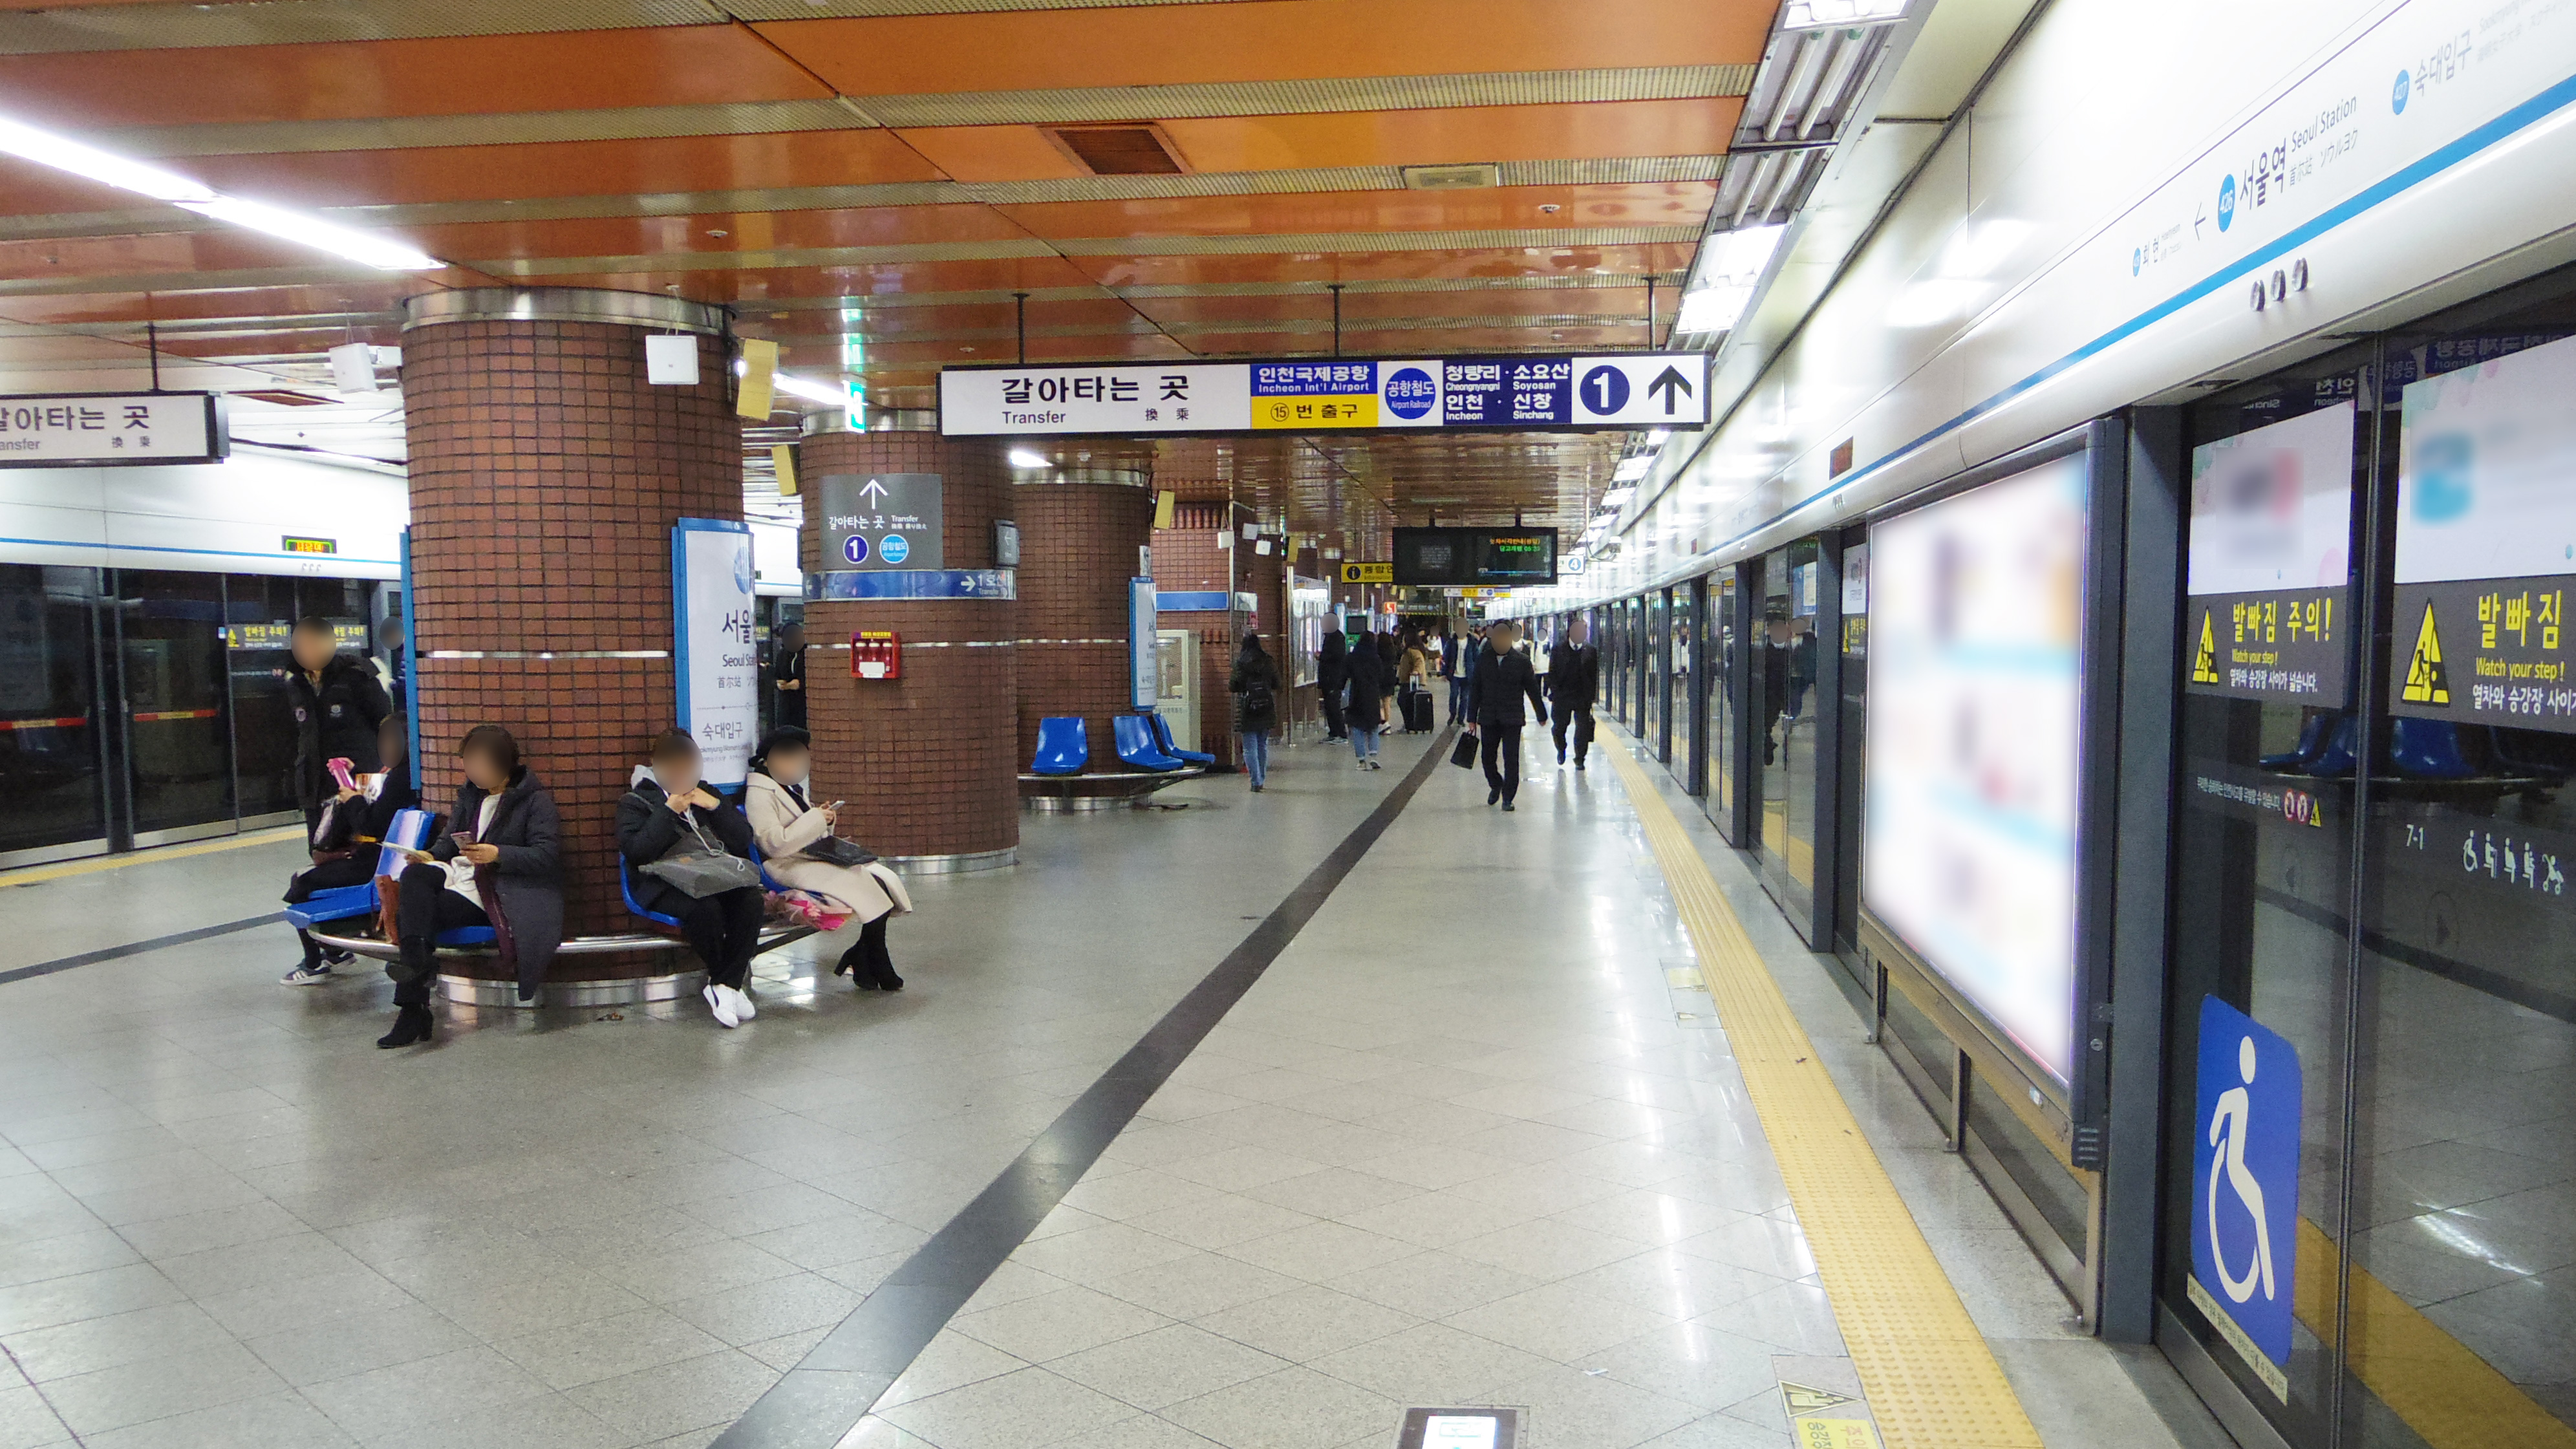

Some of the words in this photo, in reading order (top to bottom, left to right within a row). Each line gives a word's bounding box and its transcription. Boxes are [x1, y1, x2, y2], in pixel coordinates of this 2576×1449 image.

[2415, 29, 2472, 97] 숙대입구
[2292, 116, 2318, 153] Seoul
[2320, 96, 2356, 134] Station
[2240, 138, 2286, 210] 서울역
[2220, 189, 2233, 214] 426
[1258, 365, 1369, 383] 인천국제공항
[1446, 364, 1500, 381] 청량리
[1513, 364, 1570, 380] 소요산
[1002, 376, 1139, 404] 갈아타는
[1159, 375, 1189, 402] 곳
[1259, 383, 1301, 392] Incheon
[1305, 382, 1327, 392] Int'l
[1331, 382, 1369, 392] Airport
[1388, 380, 1434, 398] 공항철도
[1512, 381, 1556, 391] Soyosan
[1593, 372, 1609, 408] 1
[1296, 404, 1312, 418] 번
[1321, 403, 1358, 418] 출구
[1391, 400, 1409, 410] Airport
[1410, 400, 1431, 408] Railroad
[1446, 395, 1483, 410] 인천
[1514, 393, 1552, 409] 신창
[123, 405, 149, 429] 곳
[1002, 410, 1066, 425] Transfer
[1446, 411, 1483, 420] Incheon
[1513, 411, 1554, 420] Sinchang
[829, 515, 869, 530] 갈아타는
[873, 515, 885, 529] 곳
[850, 539, 858, 559] 1
[882, 542, 907, 551] 공항철도
[1570, 558, 1578, 570] 4
[2233, 600, 2277, 643] 발빠짐
[2287, 597, 2332, 642] 주의!
[2478, 589, 2562, 649] 발빠짐
[722, 654, 745, 667] Seoul
[2232, 649, 2248, 663] Watch
[2249, 652, 2262, 666] your
[2476, 657, 2506, 676] Watch
[2509, 663, 2532, 682] your
[2249, 670, 2268, 690] 승강장
[2268, 671, 2288, 691] 사이가
[2473, 684, 2505, 710] 열차와
[2508, 686, 2544, 714] 승강장
[702, 722, 743, 740] 숙대입구
[2407, 824, 2423, 850] 7-1
